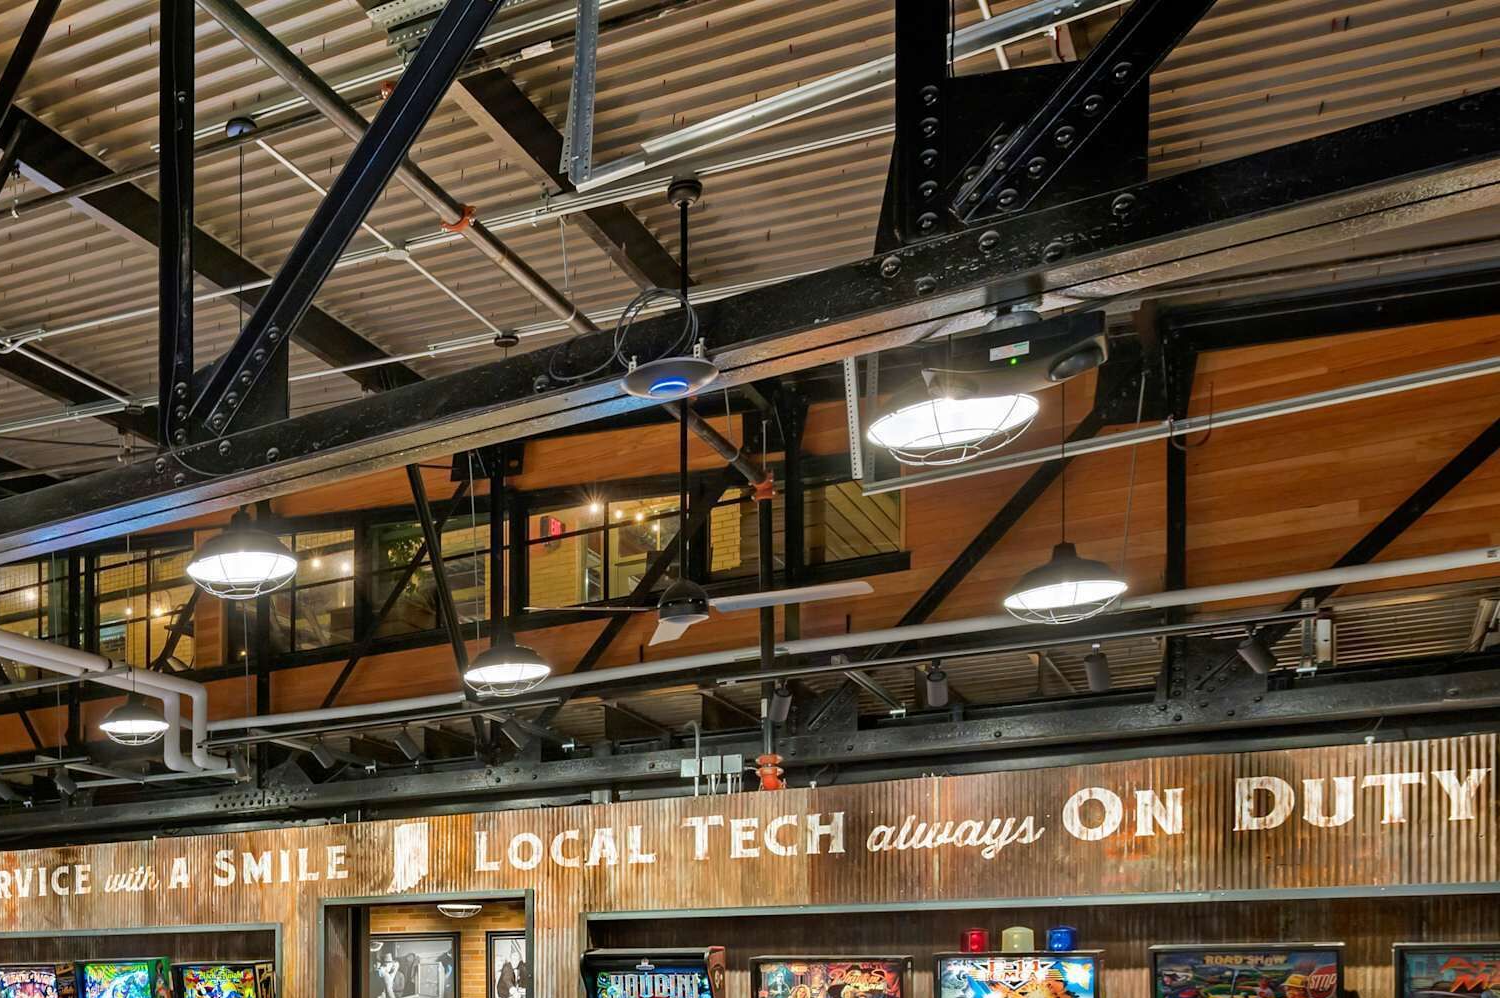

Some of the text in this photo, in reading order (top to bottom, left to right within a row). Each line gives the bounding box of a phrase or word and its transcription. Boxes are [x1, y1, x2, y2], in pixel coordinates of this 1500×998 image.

[474, 767, 1492, 873] LOCAL TECH always ON DUTY
[104, 865, 160, 893] with
[168, 857, 190, 889] A
[213, 845, 349, 887] SMILE
